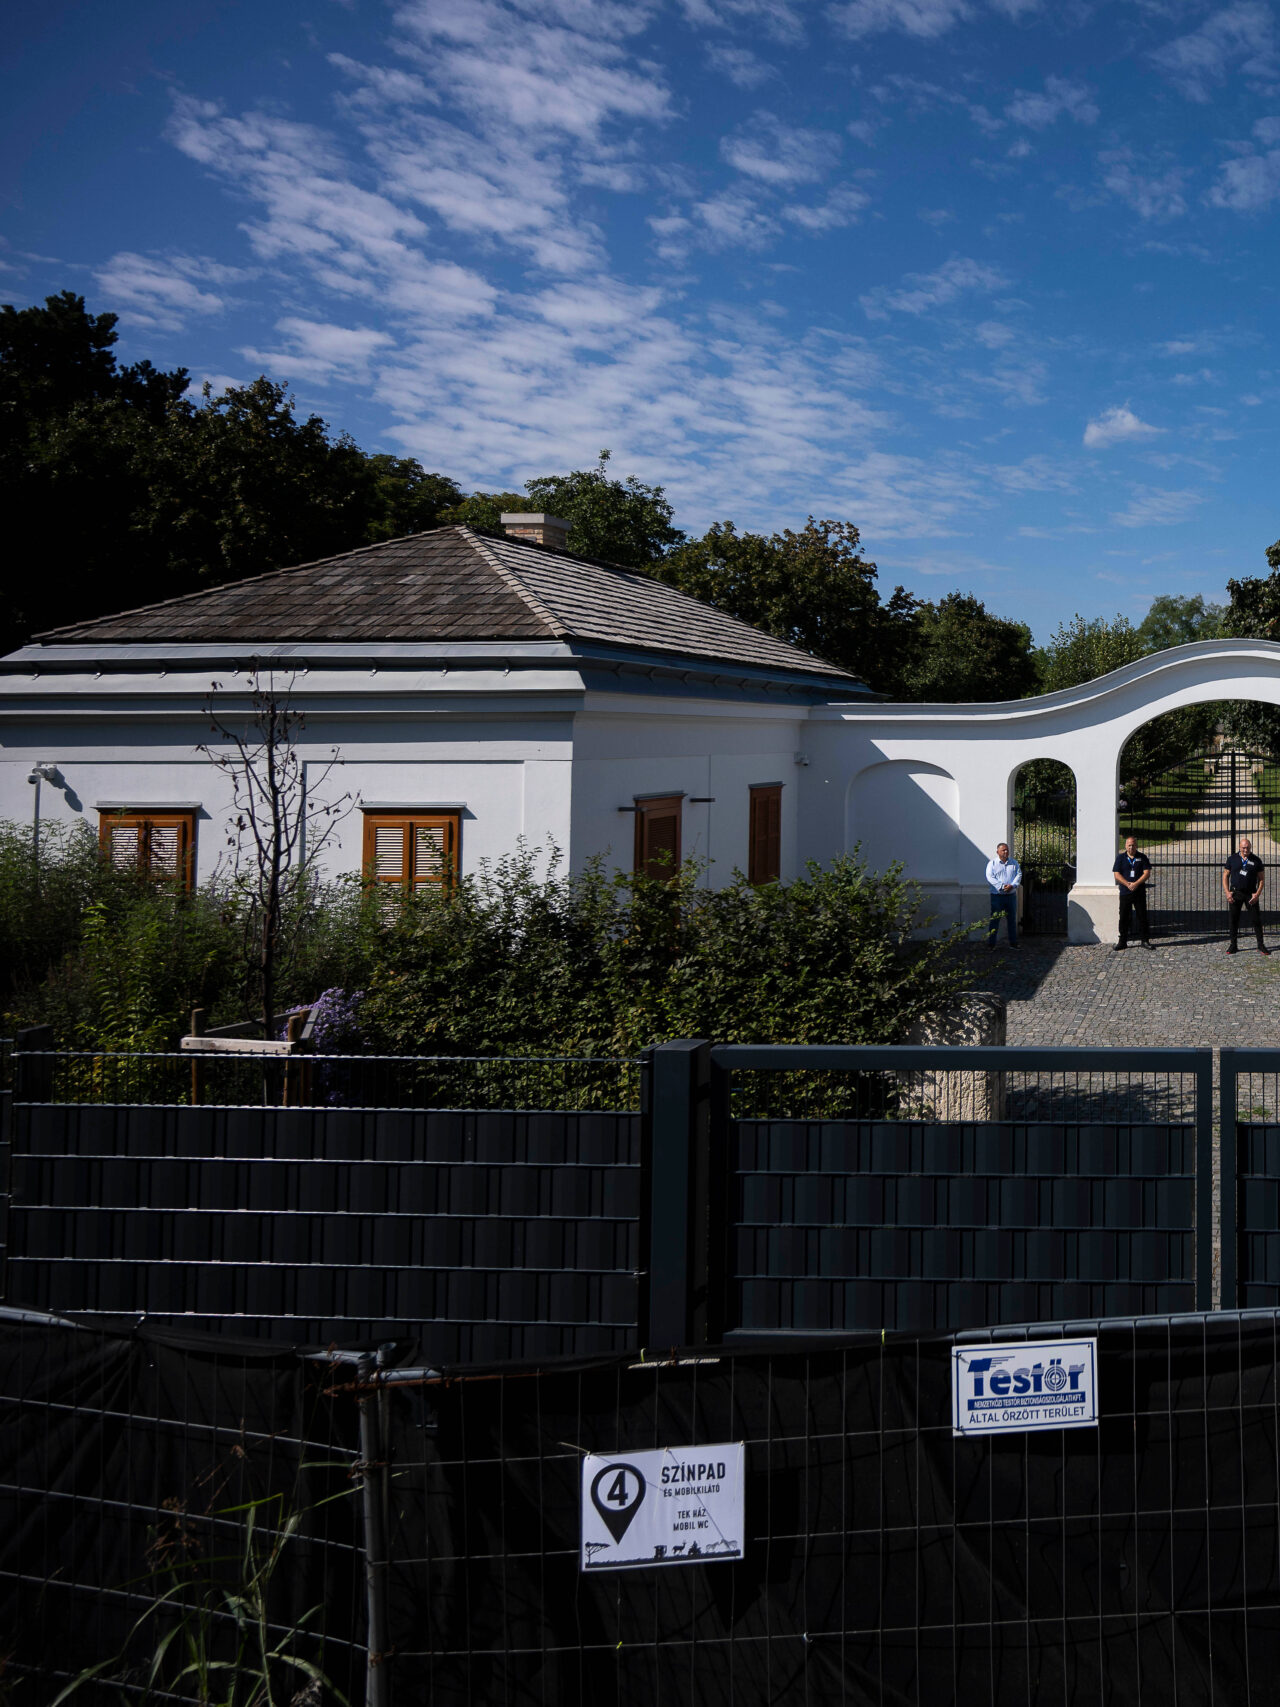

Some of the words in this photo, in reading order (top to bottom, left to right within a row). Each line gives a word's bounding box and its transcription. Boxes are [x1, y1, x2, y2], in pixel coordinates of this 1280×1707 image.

[969, 1411, 1000, 1424] ÁLTAL
[1002, 1408, 1040, 1421] ŐRZÖTT
[1042, 1406, 1086, 1418] TERÜLET
[661, 1461, 726, 1484] SZÍNPAD
[607, 1470, 629, 1506] 4
[677, 1510, 691, 1519] TEK
[692, 1507, 707, 1518] HÁZ
[673, 1522, 696, 1531] MOBIL
[697, 1520, 709, 1529] WC
